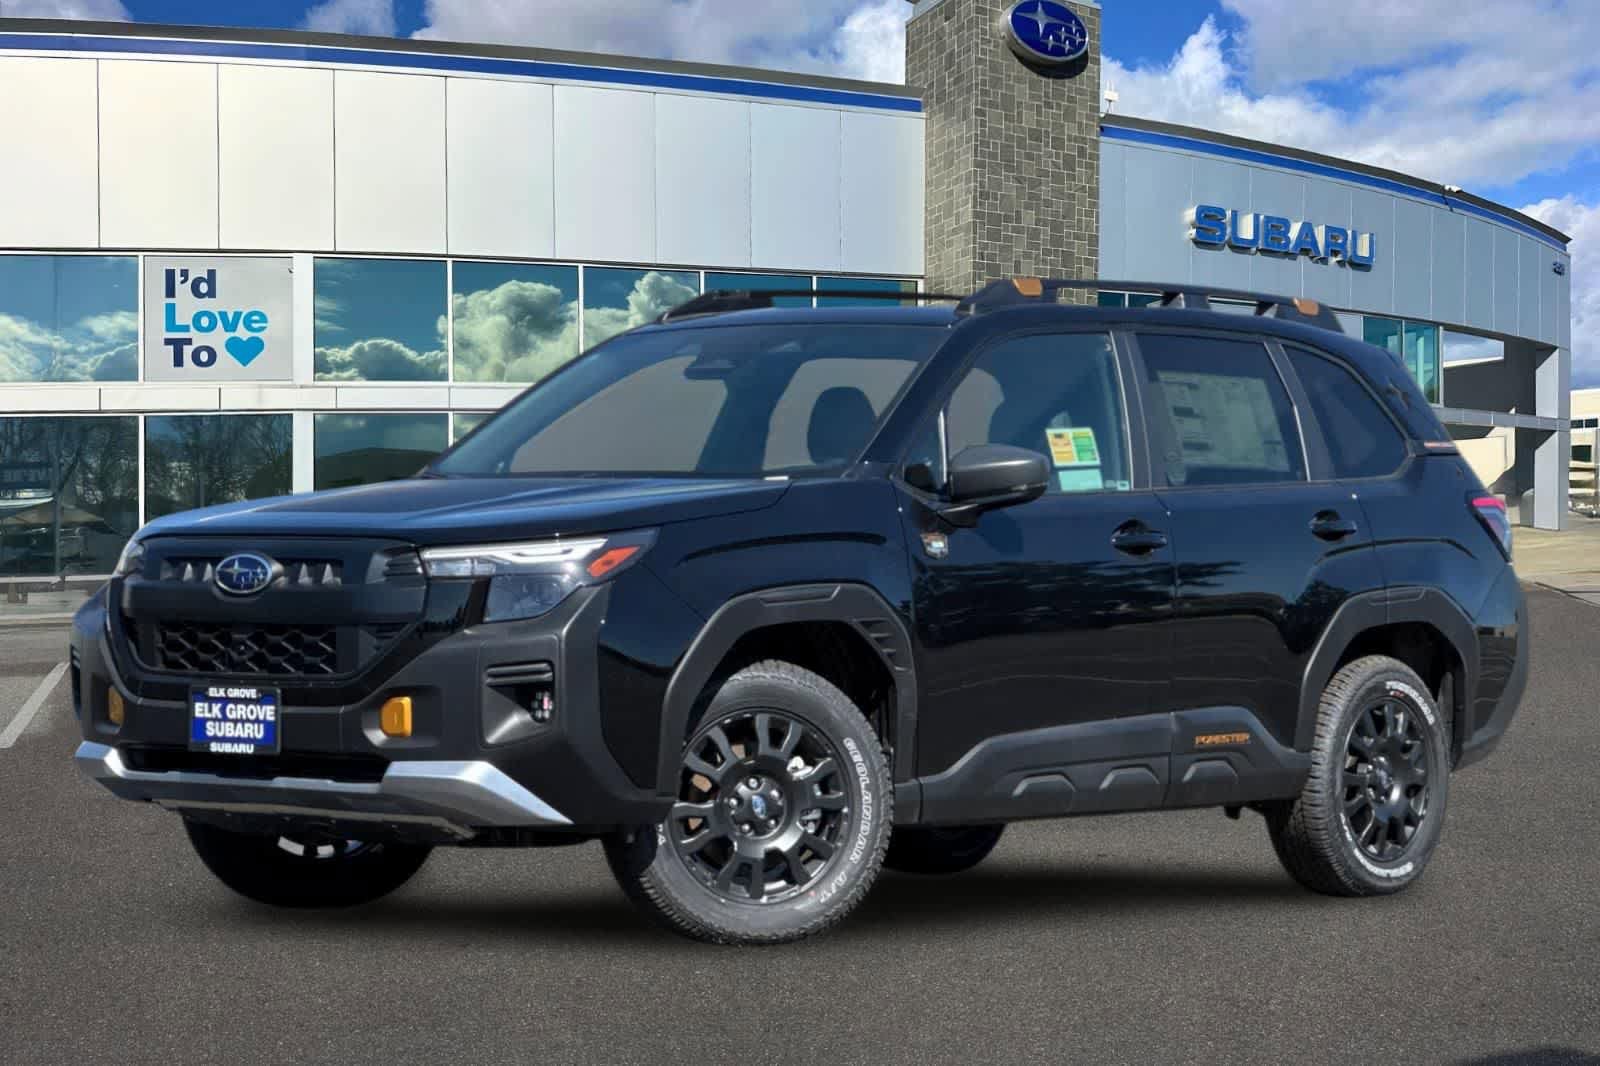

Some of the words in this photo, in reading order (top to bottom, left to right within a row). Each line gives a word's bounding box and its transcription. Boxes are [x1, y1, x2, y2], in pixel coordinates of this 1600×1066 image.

[1192, 204, 1375, 268] SUBARU
[164, 302, 269, 333] Love
[163, 337, 218, 368] To
[208, 687, 225, 697] ELK
[226, 688, 257, 698] GROVE
[194, 702, 223, 719] ELK
[225, 703, 276, 721] GROVE
[206, 721, 264, 739] SUBARU
[210, 742, 254, 754] SUBARU
